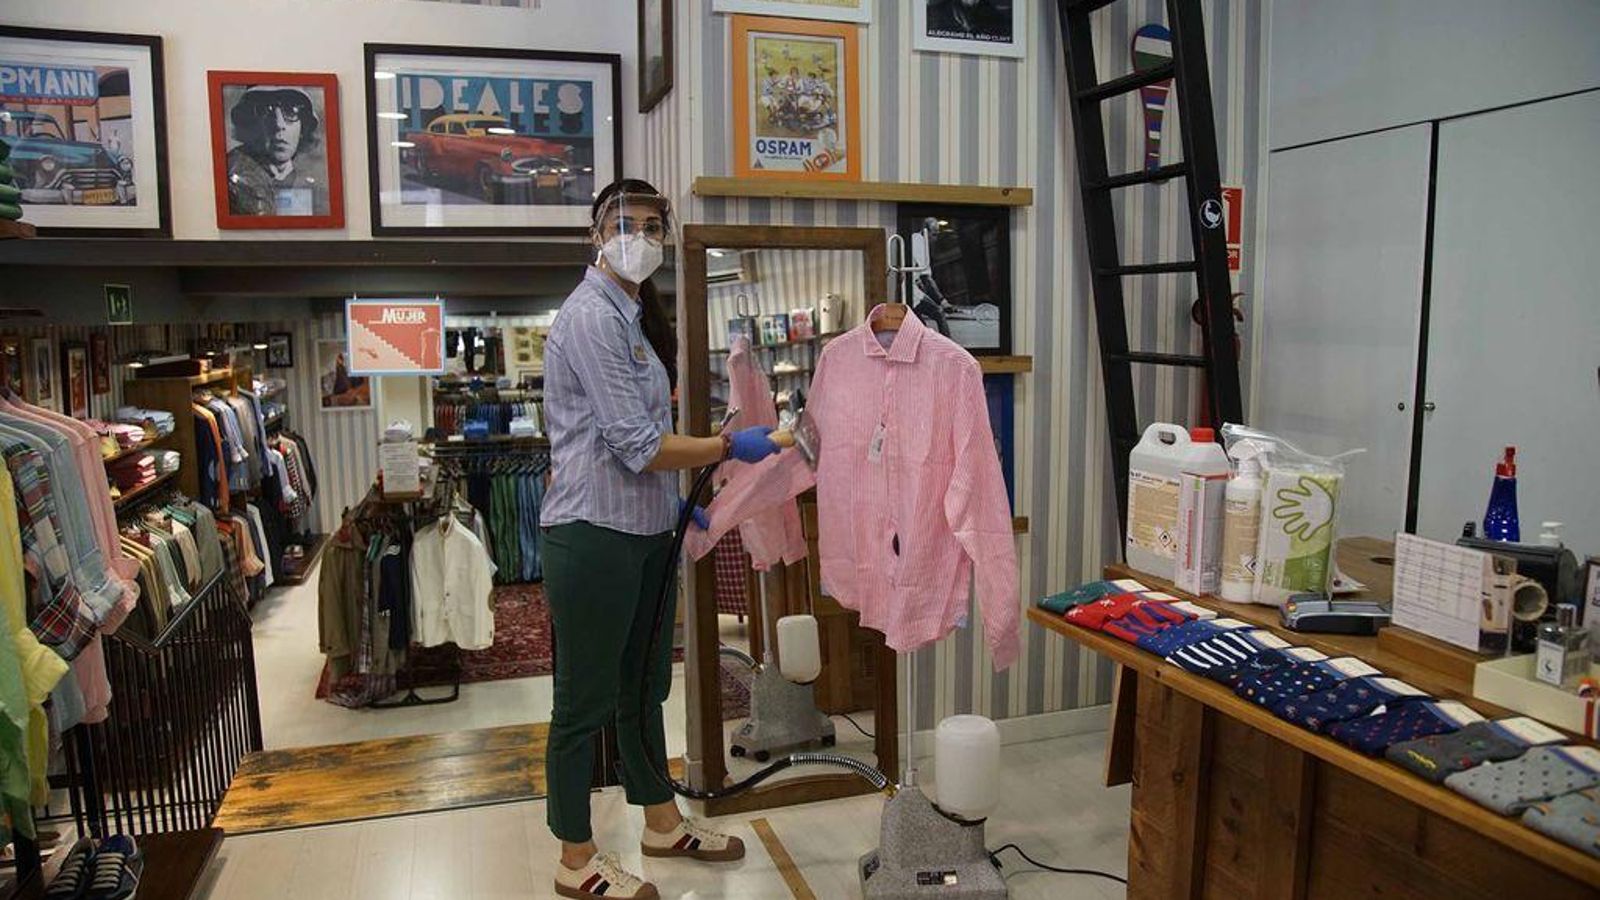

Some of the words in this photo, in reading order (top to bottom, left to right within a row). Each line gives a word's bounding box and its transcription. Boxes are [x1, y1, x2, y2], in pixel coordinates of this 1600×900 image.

[401, 76, 584, 115] IDEALES
[756, 139, 812, 156] OSRAM
[382, 307, 427, 324] MUJER
